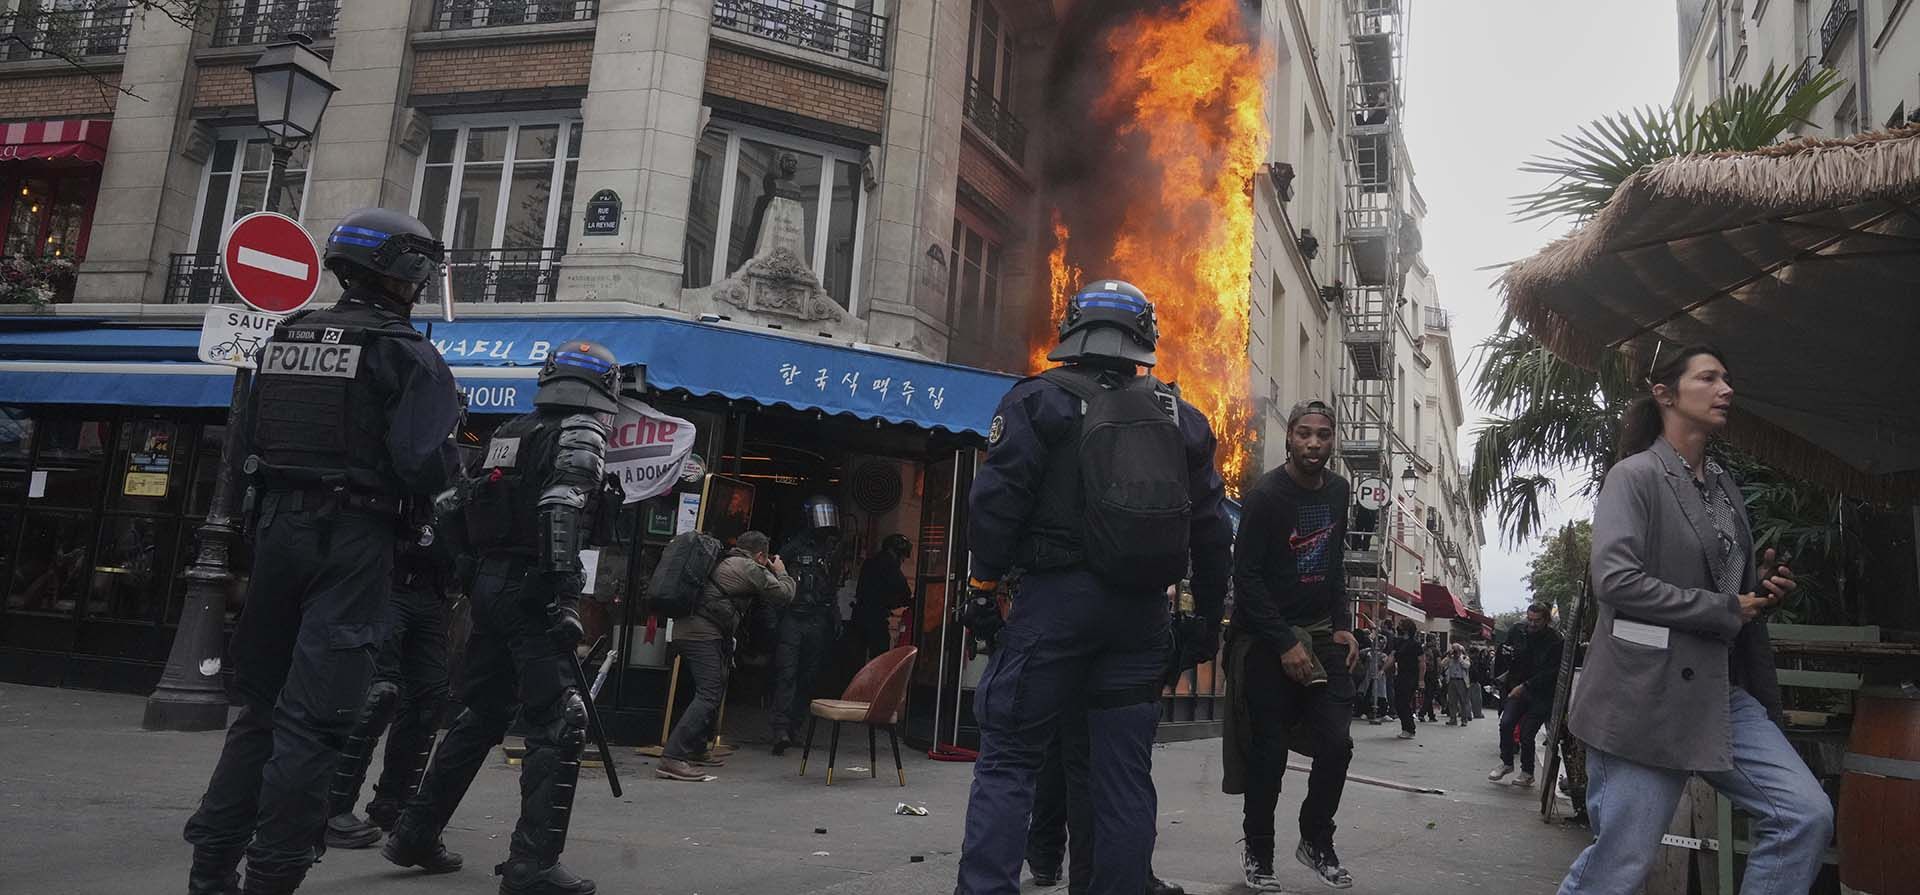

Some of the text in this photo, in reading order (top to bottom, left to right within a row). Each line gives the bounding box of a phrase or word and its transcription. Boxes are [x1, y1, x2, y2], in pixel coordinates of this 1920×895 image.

[227, 313, 276, 331] SAUF
[267, 345, 350, 373] POLICE
[463, 386, 516, 407] HOUR
[492, 445, 509, 460] 112
[1360, 486, 1386, 502] PB
